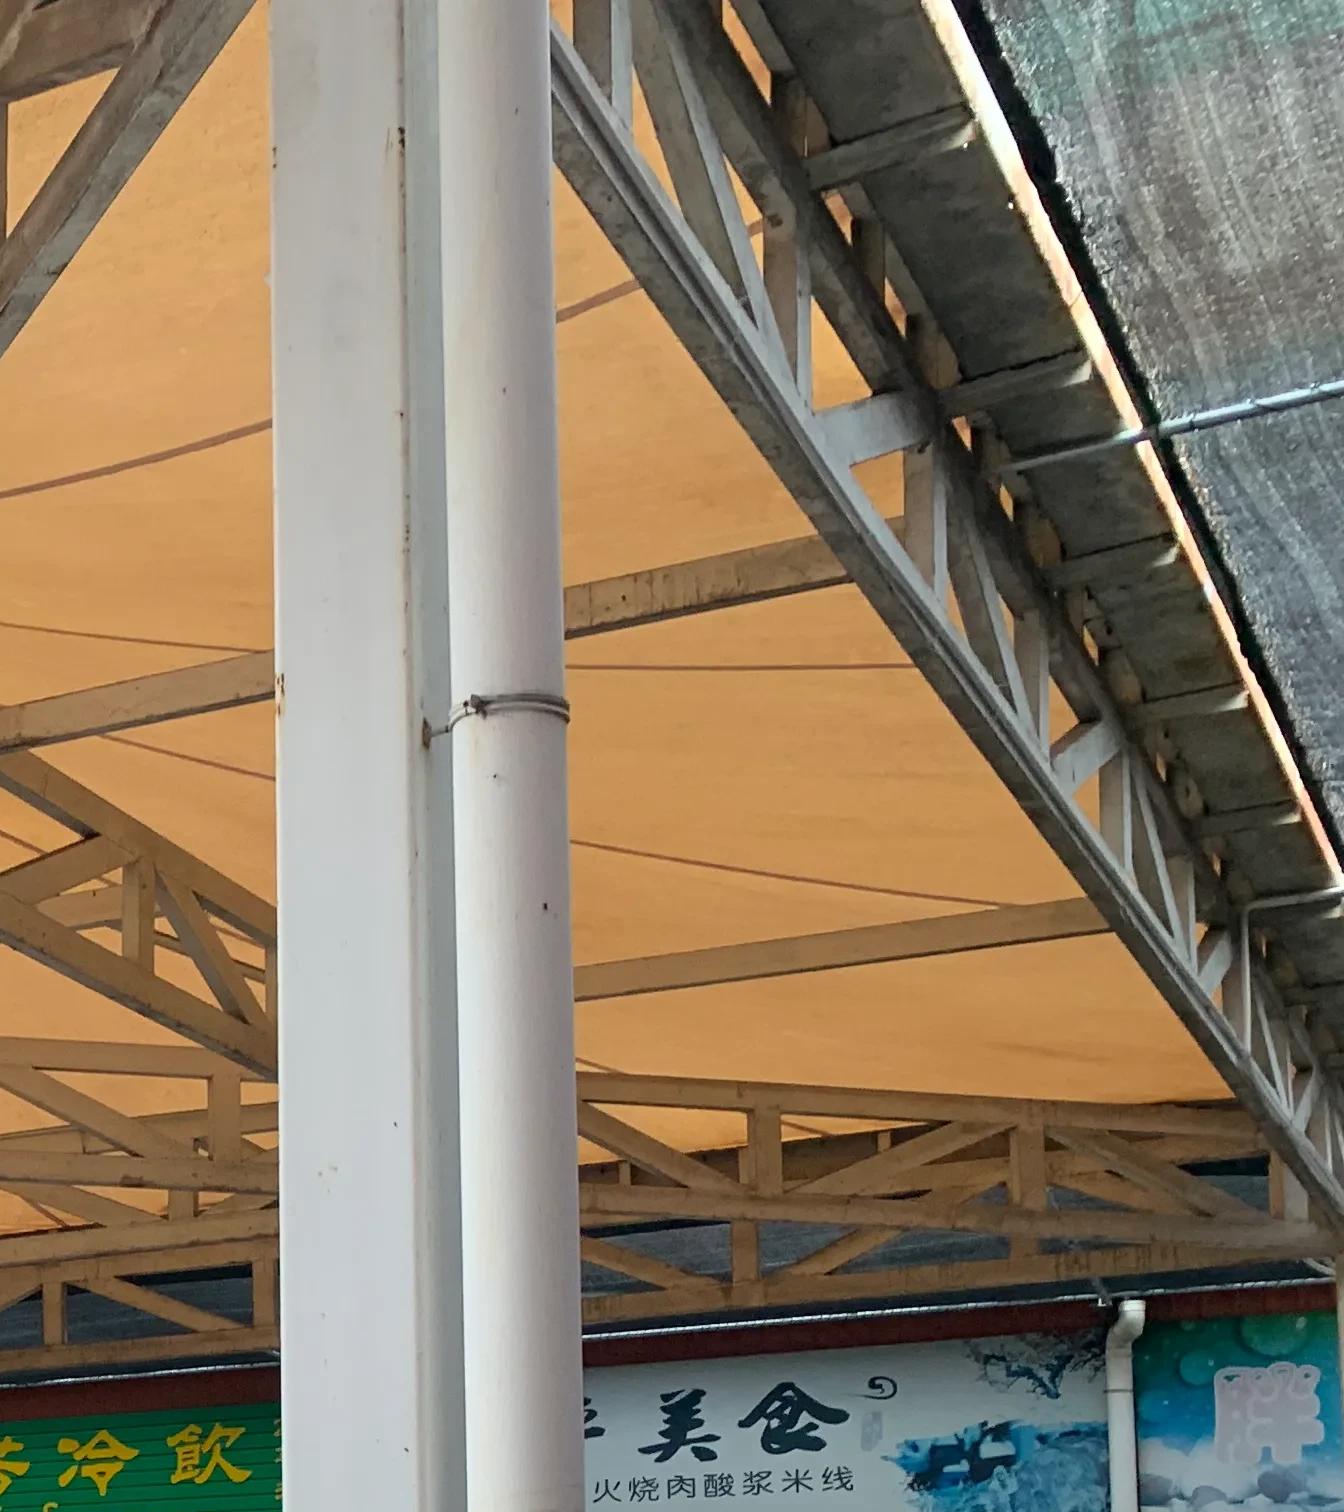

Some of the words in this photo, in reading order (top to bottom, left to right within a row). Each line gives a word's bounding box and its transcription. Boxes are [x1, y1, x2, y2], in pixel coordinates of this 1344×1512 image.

[593, 1466, 855, 1502] 火烧肉酸浆米线
